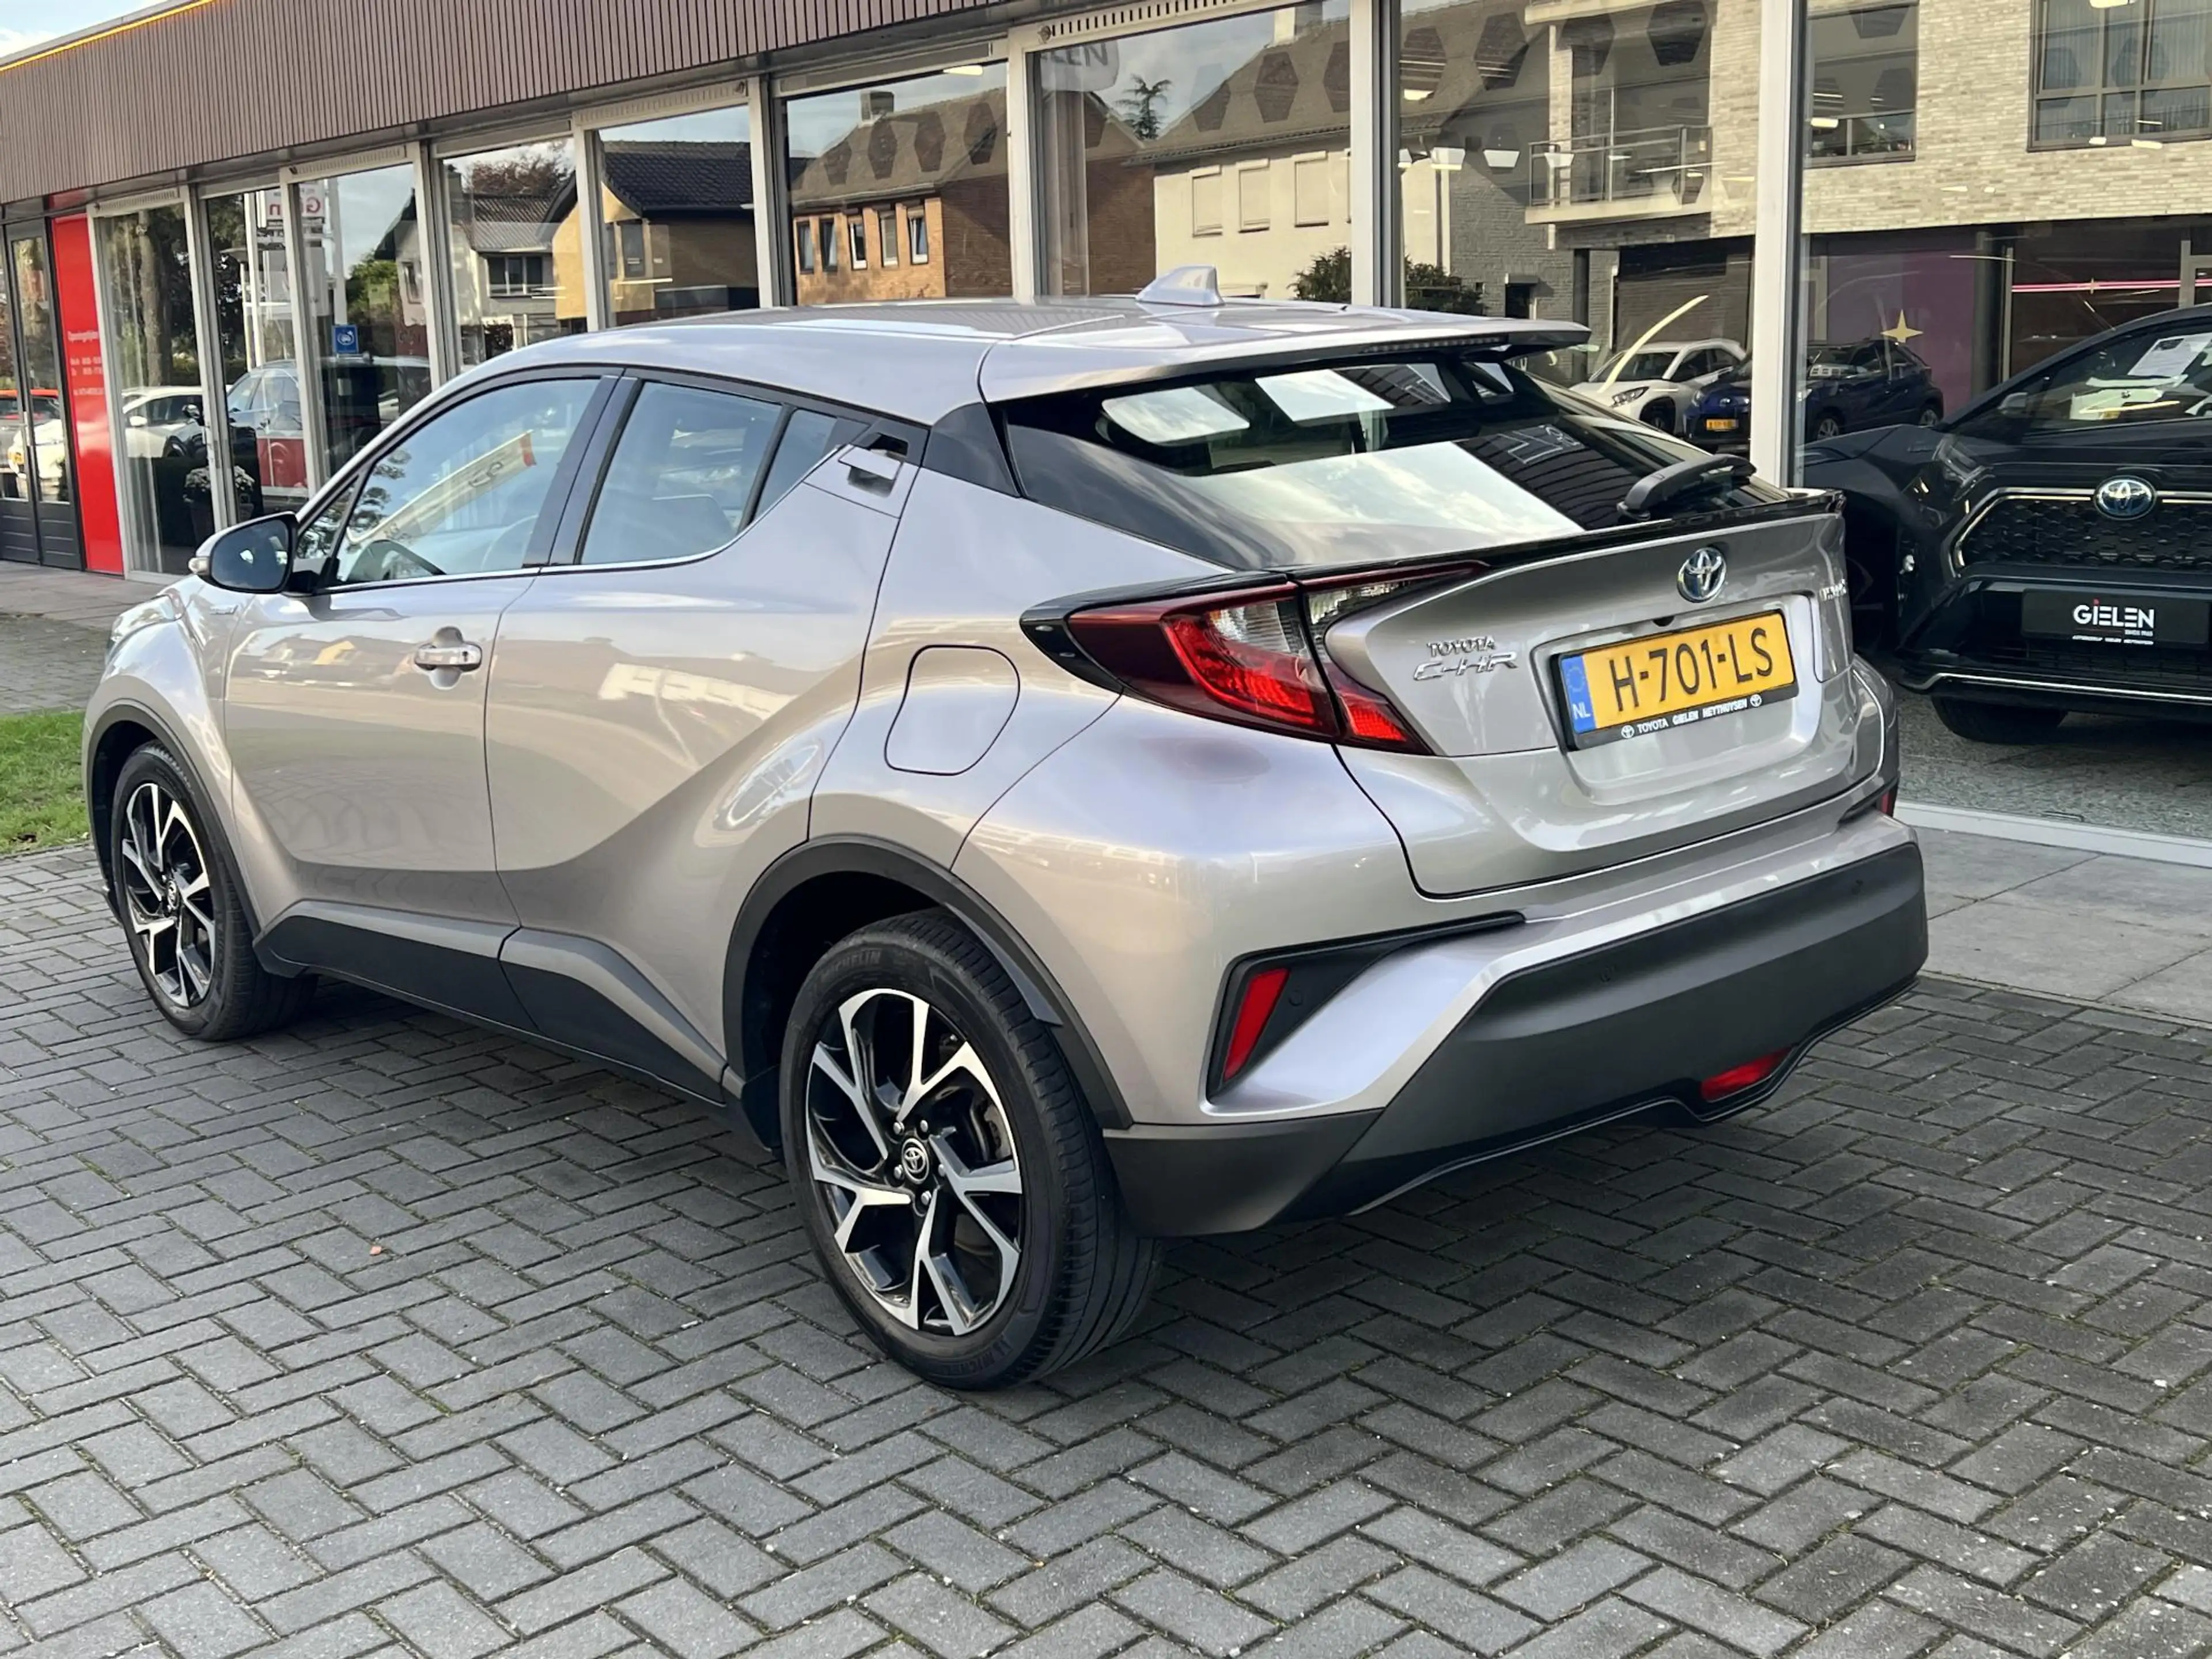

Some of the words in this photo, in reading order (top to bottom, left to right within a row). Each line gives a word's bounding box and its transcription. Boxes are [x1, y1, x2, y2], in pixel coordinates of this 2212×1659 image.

[2073, 599, 2154, 628] GIELEN
[1427, 635, 1495, 657] TOYOTA
[1414, 652, 1518, 681] C-HR
[1609, 627, 1773, 712] H-701-LS
[1572, 703, 1590, 720] NL
[1637, 718, 1669, 733] TOYOTA
[1672, 710, 1699, 725] GIELEN
